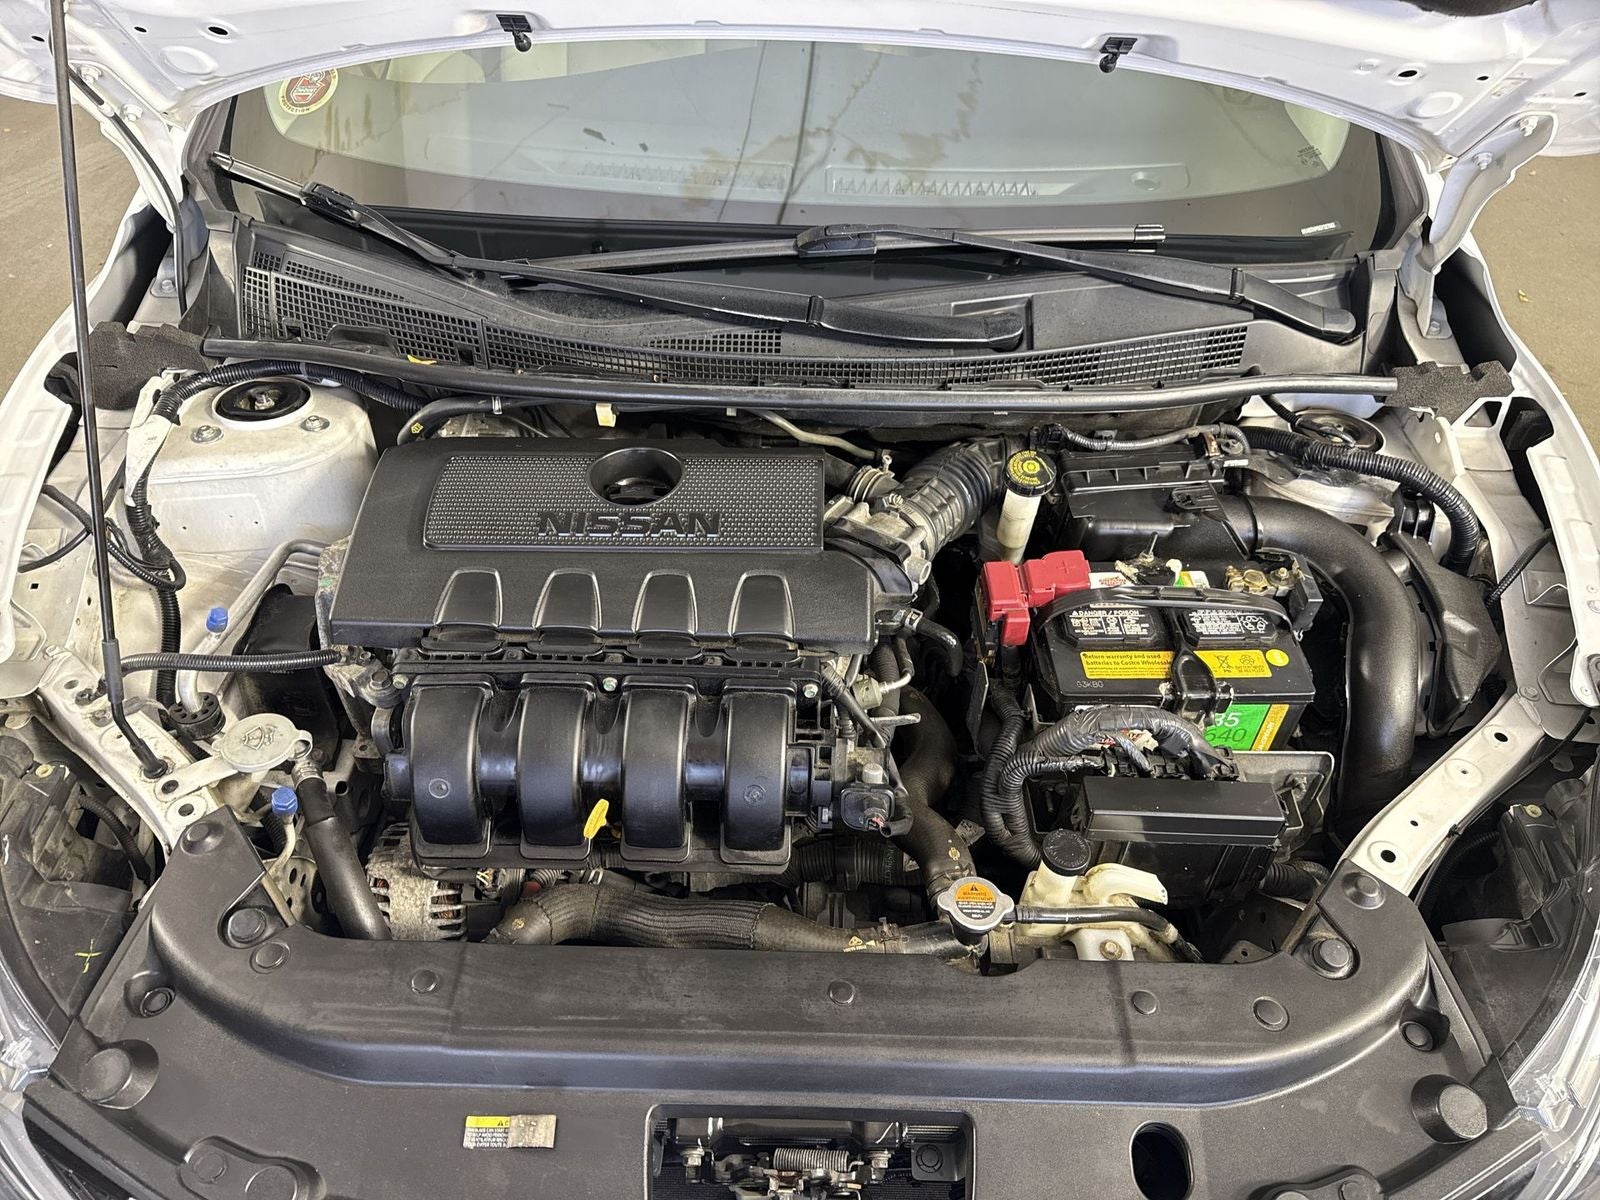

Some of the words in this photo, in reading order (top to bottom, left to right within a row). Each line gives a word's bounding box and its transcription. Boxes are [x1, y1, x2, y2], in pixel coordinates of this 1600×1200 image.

[537, 512, 722, 538] NISSAN
[1214, 712, 1242, 728] 35
[1204, 728, 1248, 743] 640
